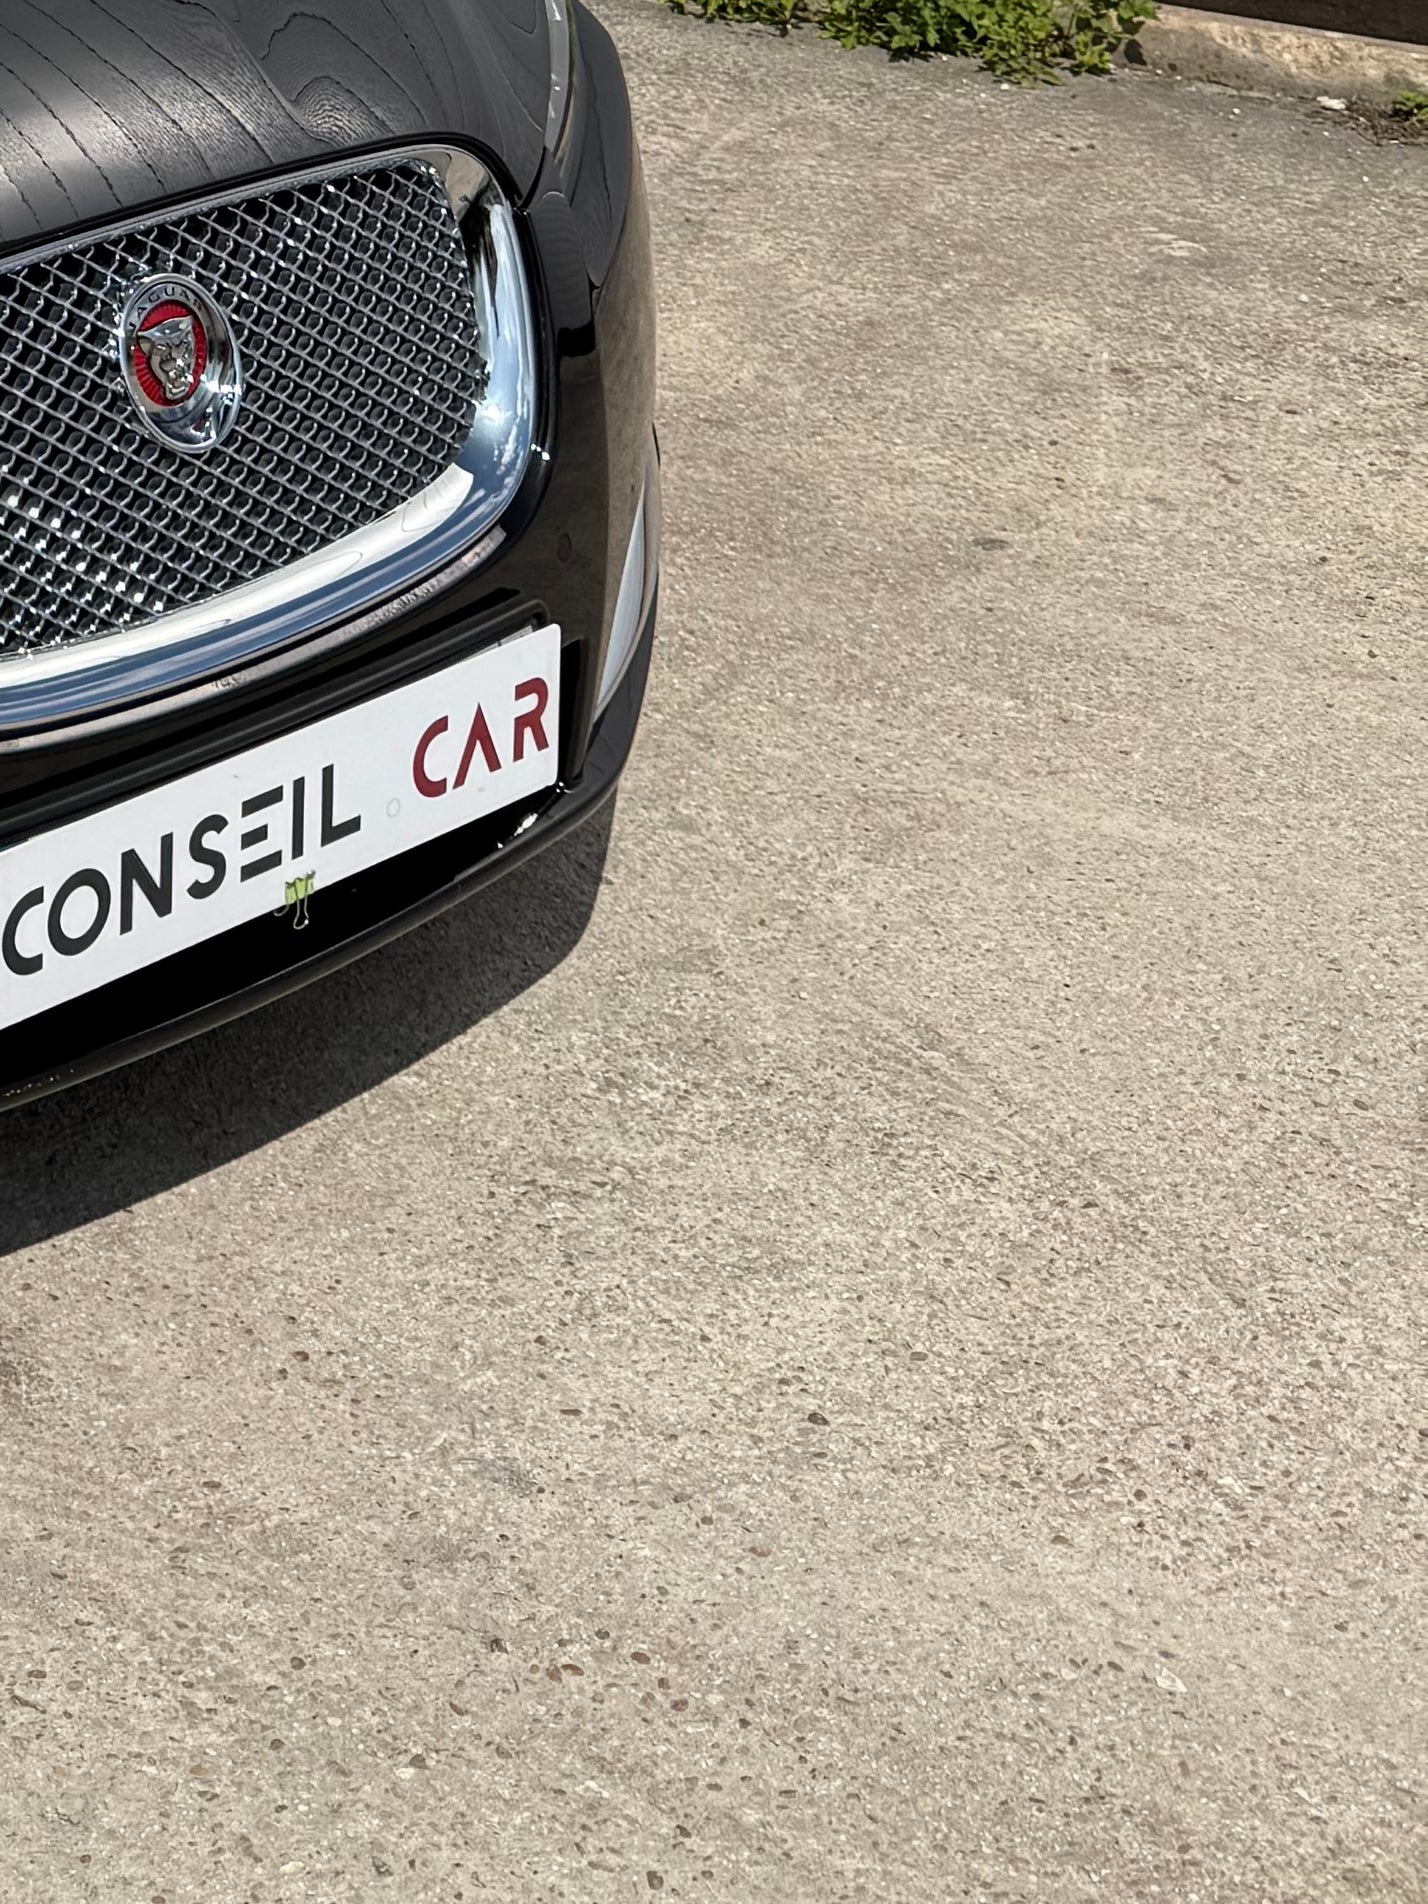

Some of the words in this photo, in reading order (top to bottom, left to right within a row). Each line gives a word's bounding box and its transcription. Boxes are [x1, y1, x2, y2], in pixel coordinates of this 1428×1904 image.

[128, 286, 203, 331] JAGUAR
[0, 763, 363, 977] CONSEIL
[413, 678, 548, 798] CAR
